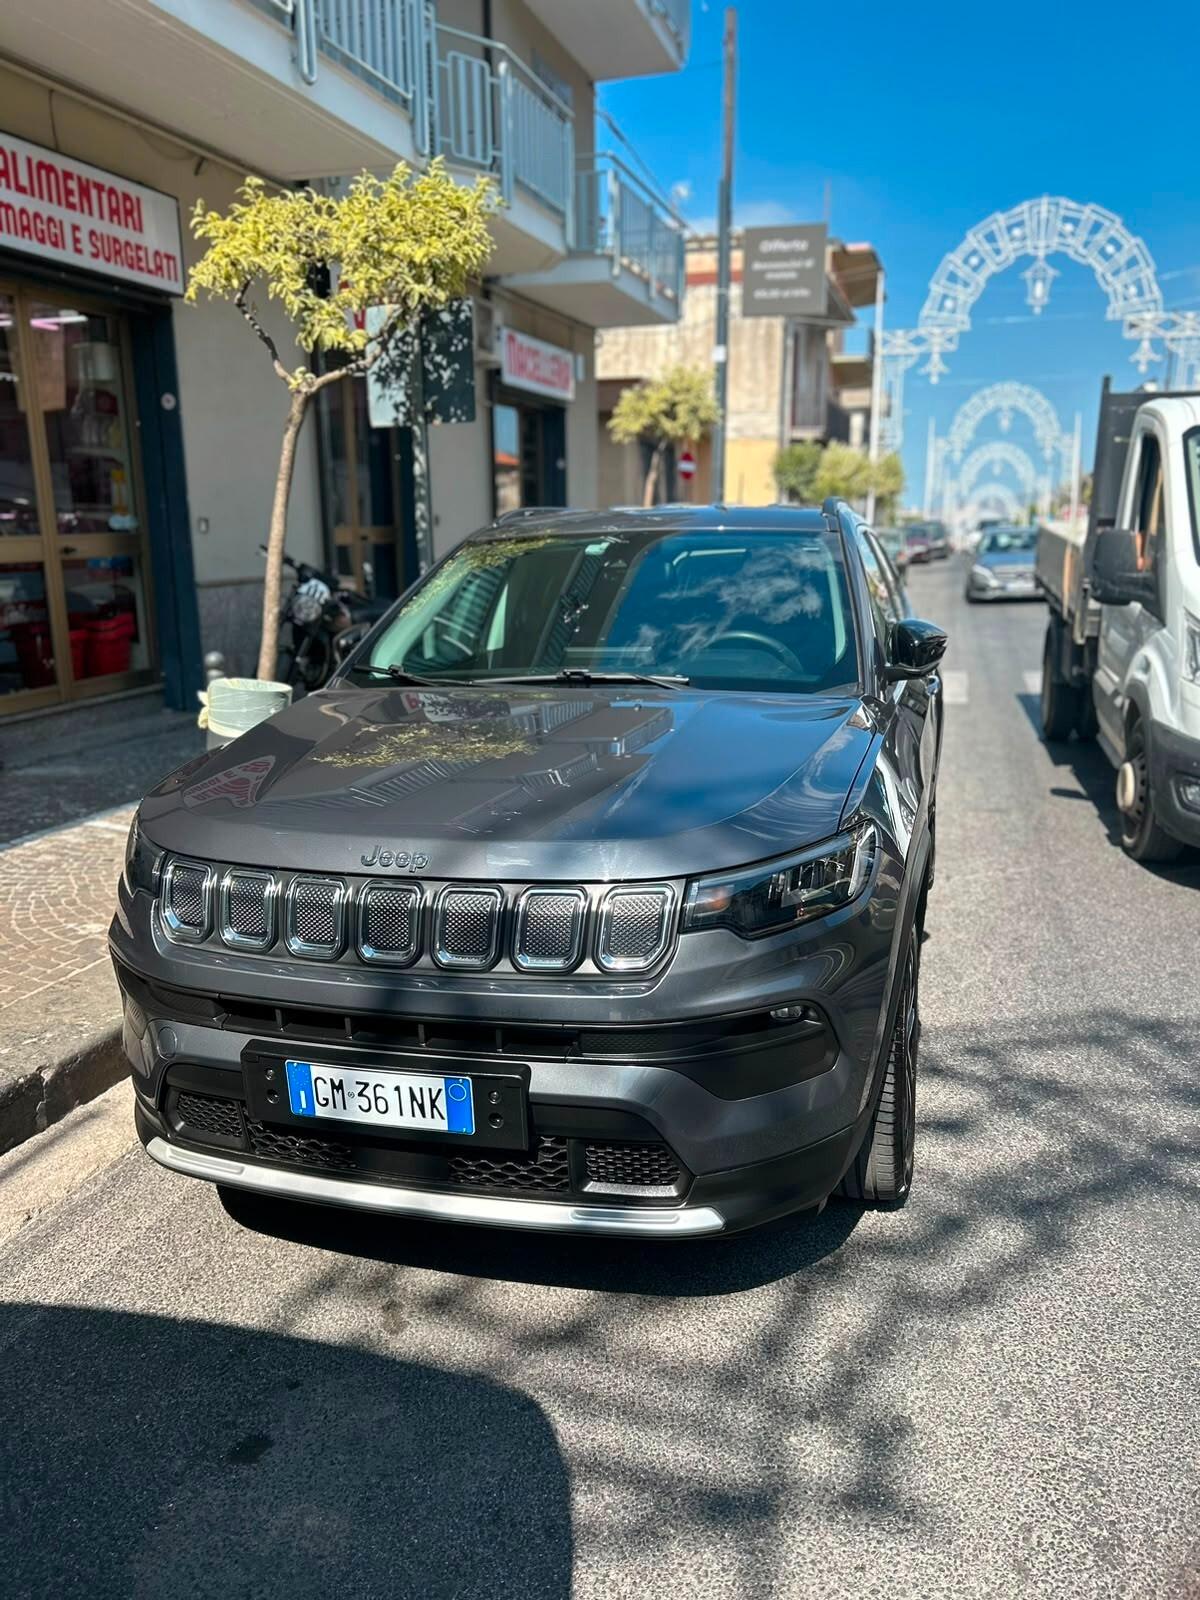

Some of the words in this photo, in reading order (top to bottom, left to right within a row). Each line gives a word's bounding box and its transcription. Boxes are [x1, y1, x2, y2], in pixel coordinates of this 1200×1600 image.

[0, 146, 143, 233] ALIMENTARI
[0, 202, 66, 250] MAGGI
[71, 223, 83, 255] E
[89, 229, 178, 282] SURGELATI
[360, 845, 430, 873] Jeep
